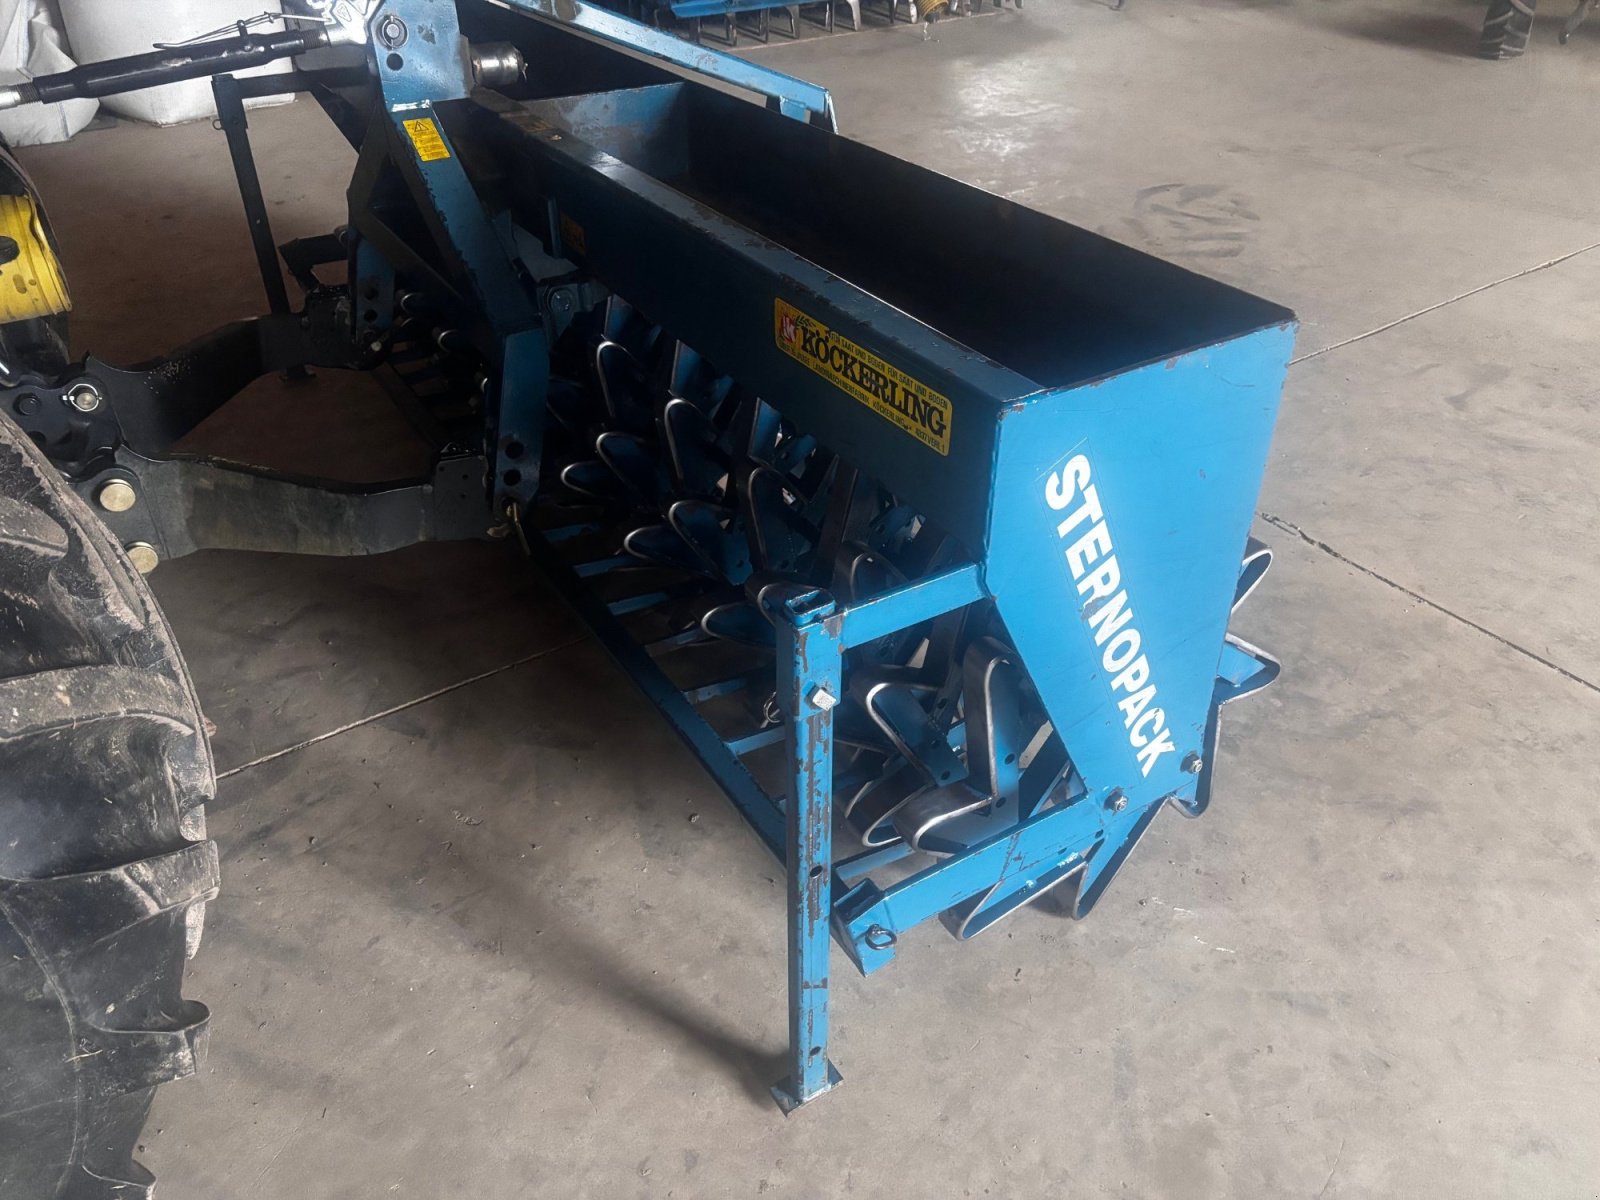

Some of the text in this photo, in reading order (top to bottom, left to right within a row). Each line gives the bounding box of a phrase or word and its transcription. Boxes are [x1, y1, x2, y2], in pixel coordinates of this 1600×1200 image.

[801, 326, 947, 438] KÖCKERLING
[915, 382, 927, 397] UND
[1045, 454, 1175, 778] STERNOPACK
